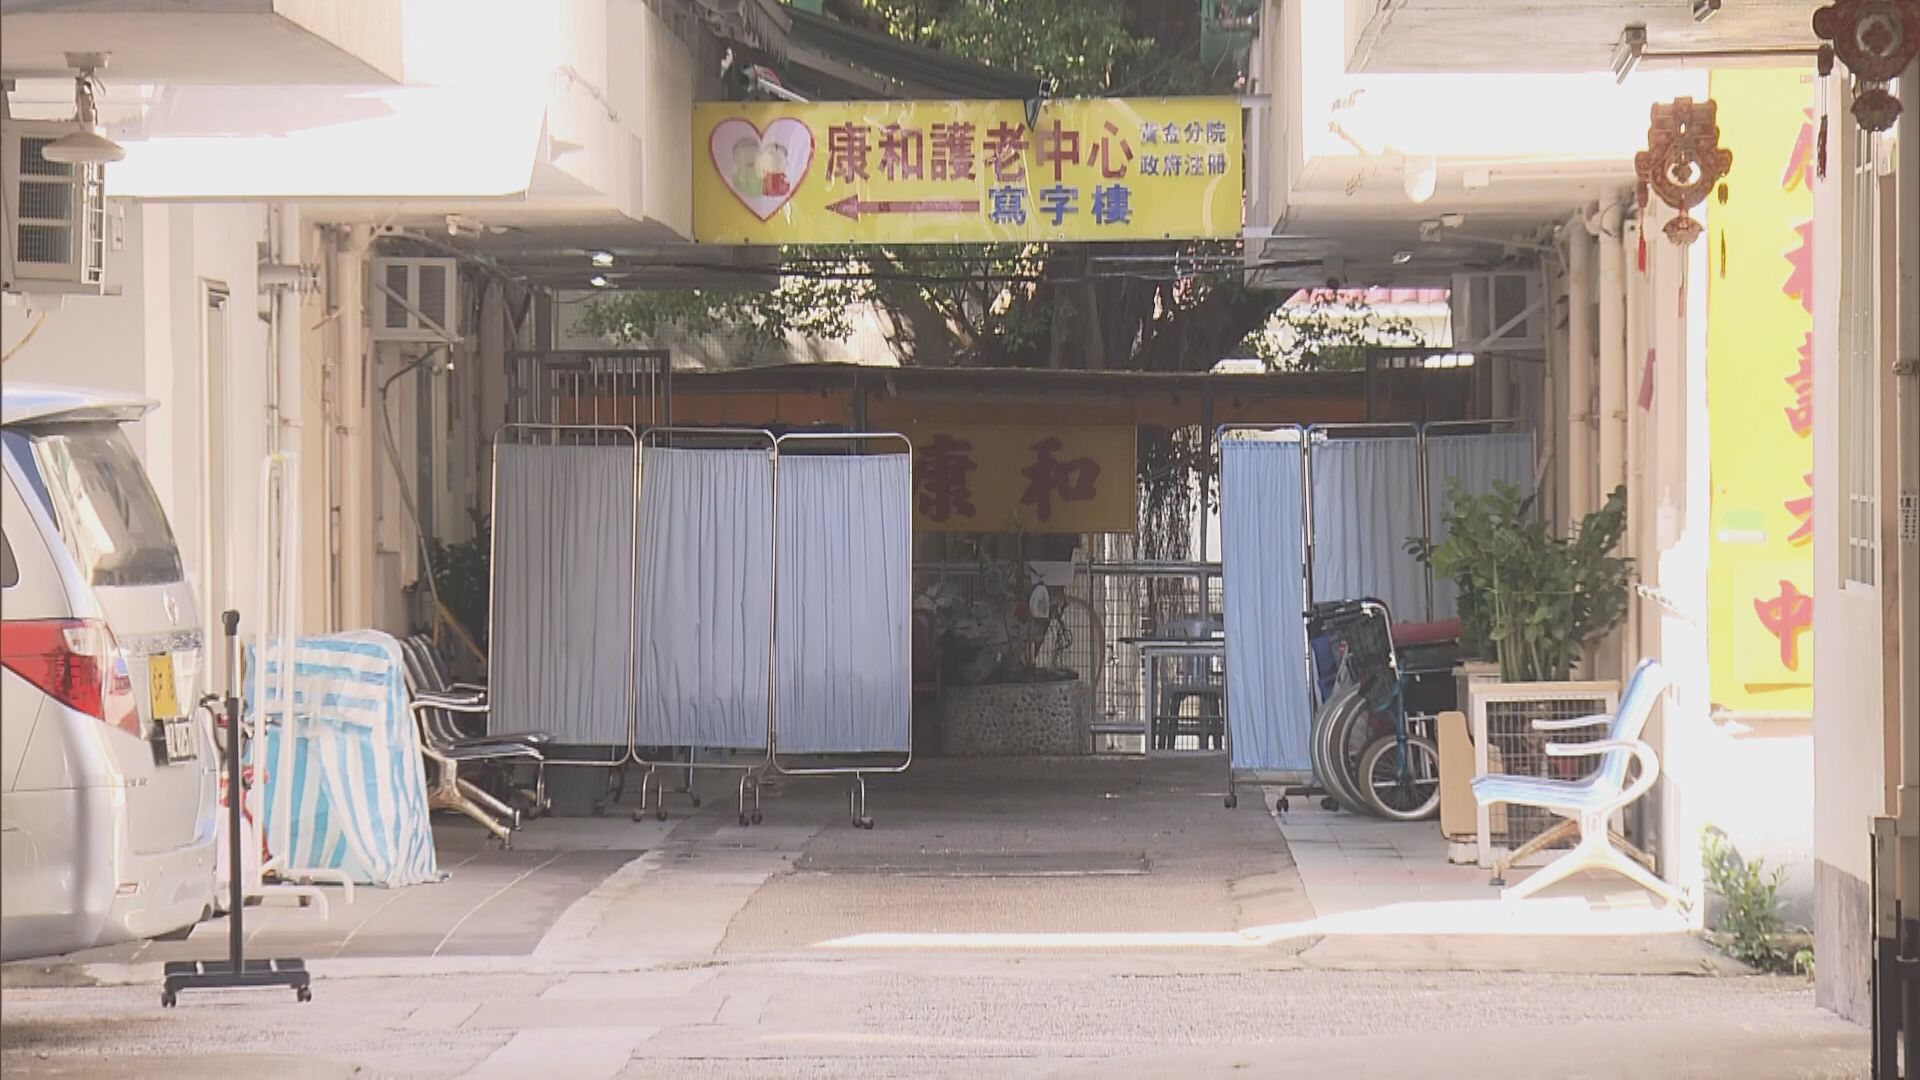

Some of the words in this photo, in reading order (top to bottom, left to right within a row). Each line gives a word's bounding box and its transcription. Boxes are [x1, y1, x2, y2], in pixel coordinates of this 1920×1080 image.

[825, 120, 1133, 183] 康和護老中心
[988, 183, 1133, 226] 寫字樓
[915, 433, 1100, 522] 康和
